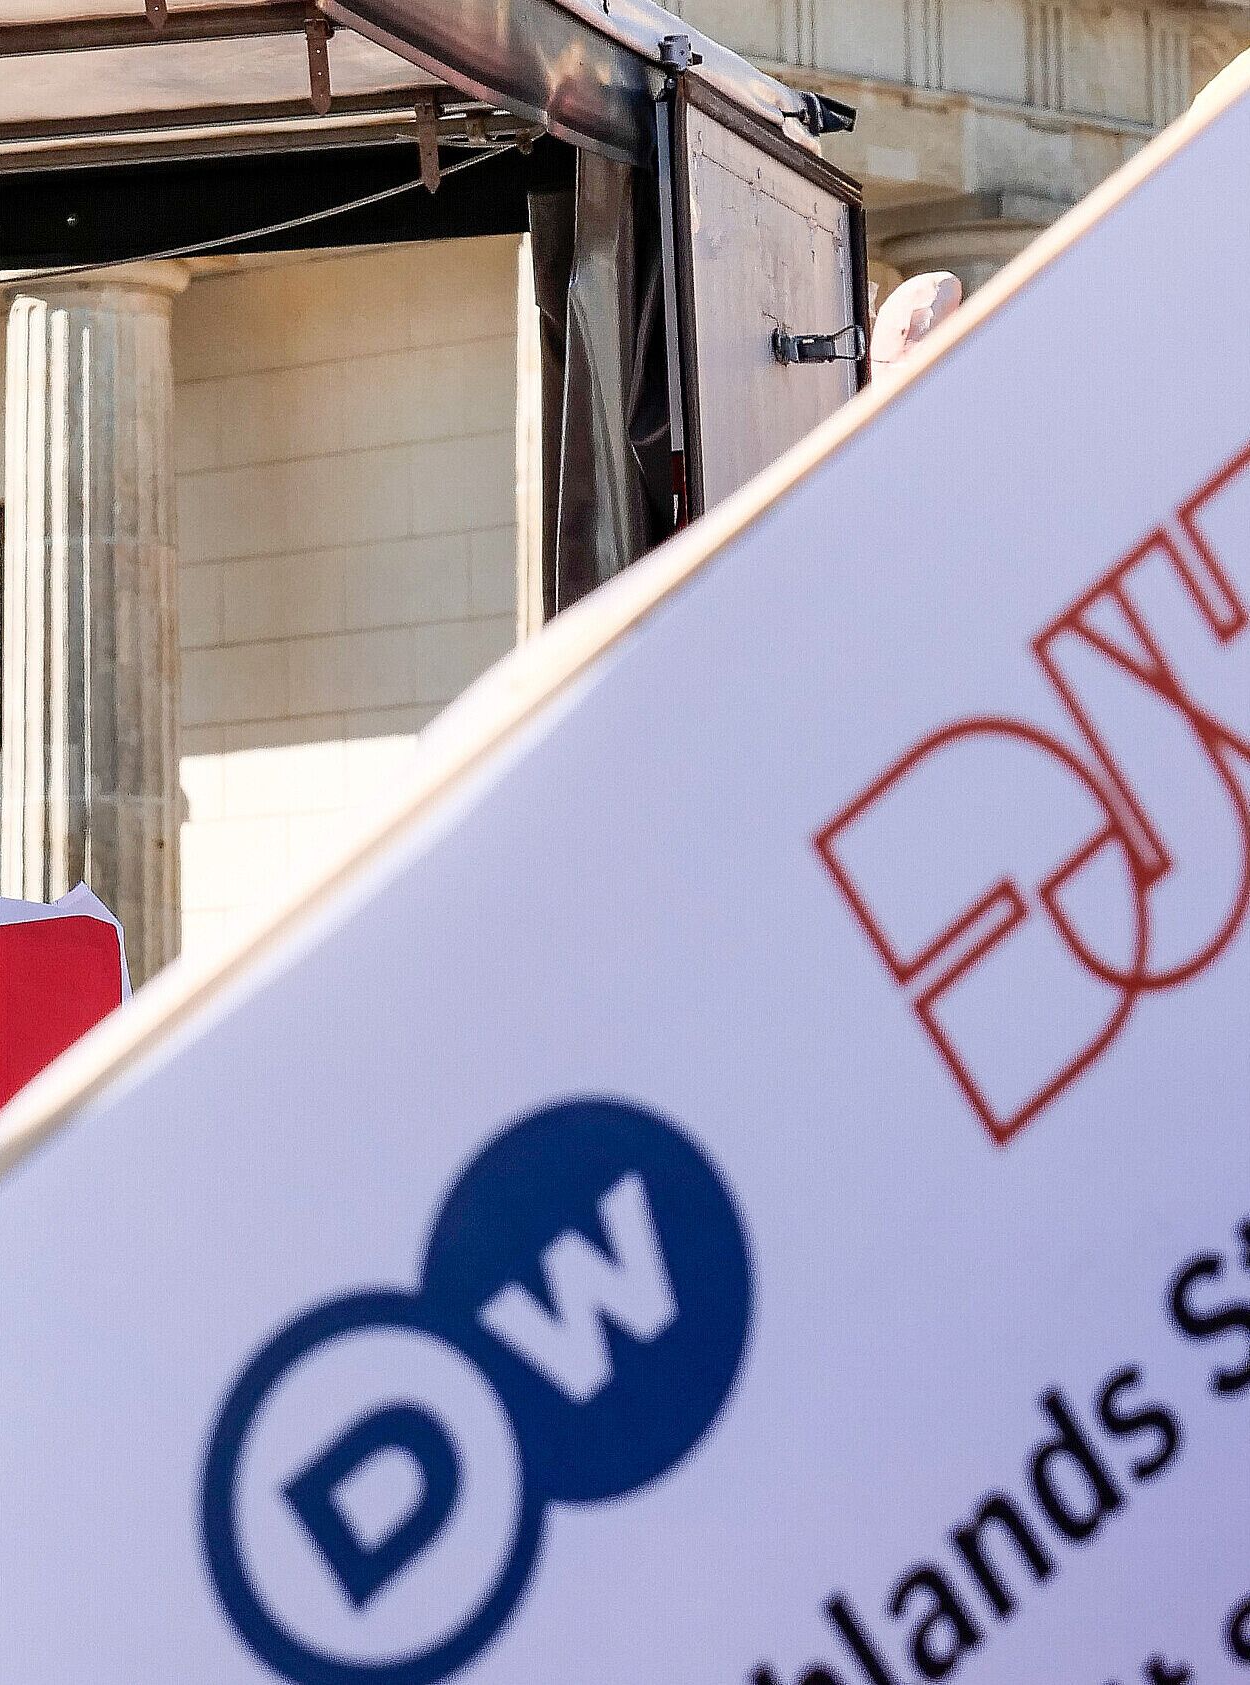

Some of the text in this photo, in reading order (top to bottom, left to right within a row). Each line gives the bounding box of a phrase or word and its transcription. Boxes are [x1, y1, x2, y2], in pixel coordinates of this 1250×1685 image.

[279, 1170, 679, 1612] DW
[748, 1218, 1250, 1685] lands S
